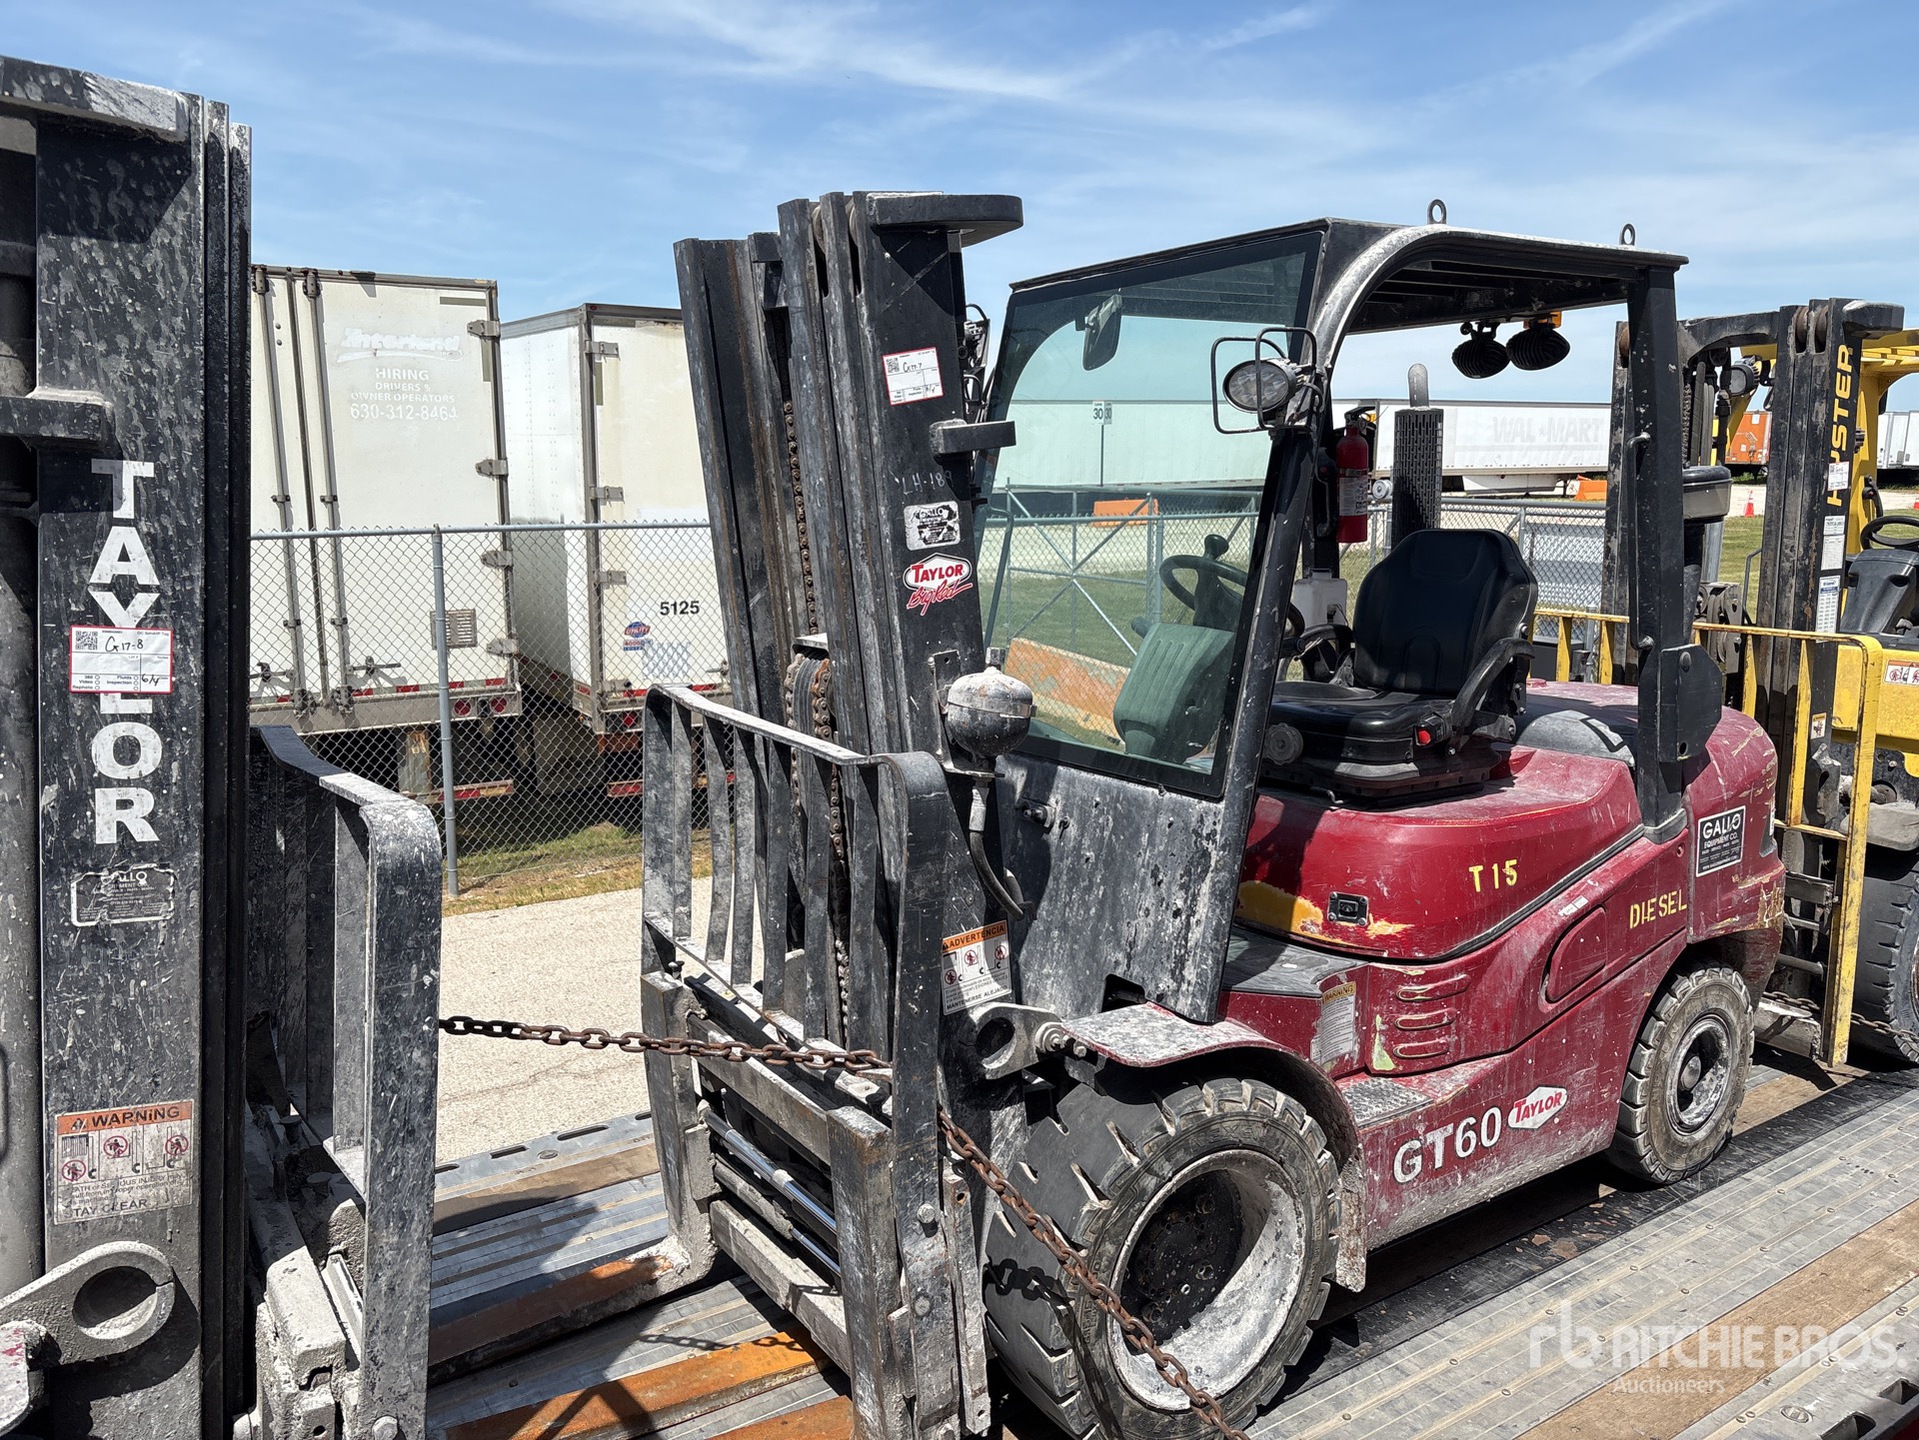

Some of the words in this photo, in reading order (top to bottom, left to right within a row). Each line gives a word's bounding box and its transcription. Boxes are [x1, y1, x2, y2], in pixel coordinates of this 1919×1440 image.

[375, 367, 429, 380] HIRING
[375, 382, 420, 391] DRIVERS
[424, 383, 431, 392] &
[350, 392, 391, 401] OWNER
[393, 393, 455, 403] OPERATORS
[1093, 407, 1104, 420] 30
[911, 564, 964, 583] TAYLOR
[660, 601, 700, 616] 5125
[1469, 865, 1483, 892] T
[1492, 859, 1517, 889] 15
[1629, 888, 1687, 929] DIESEL
[948, 925, 1005, 948] ADVERTENCIA
[92, 1106, 180, 1127] WARNING
[1513, 1091, 1563, 1124] TAYLOR
[1393, 1107, 1502, 1183] GT60
[102, 1199, 147, 1213] CLEAR
